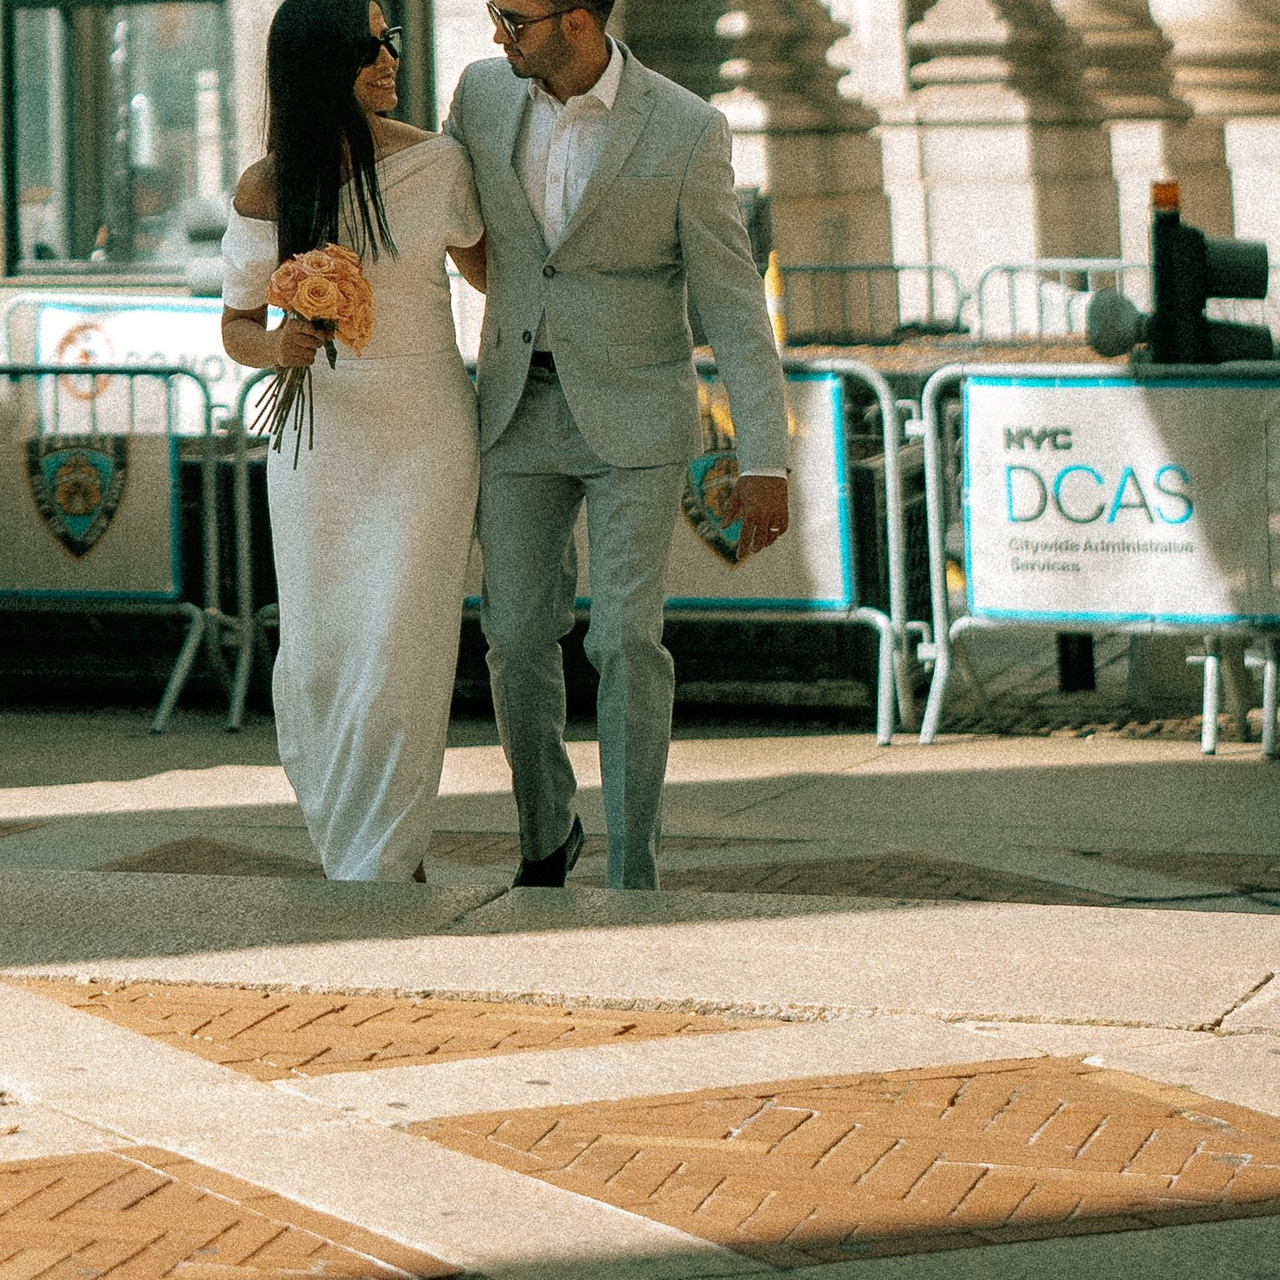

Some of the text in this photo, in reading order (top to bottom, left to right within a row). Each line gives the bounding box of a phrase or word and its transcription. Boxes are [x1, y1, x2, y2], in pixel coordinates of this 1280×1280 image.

[1004, 426, 1073, 450] NYC
[1005, 464, 1194, 524] DCAS
[1009, 537, 1195, 555] Citywide Administrative
[1011, 557, 1080, 573] Services
